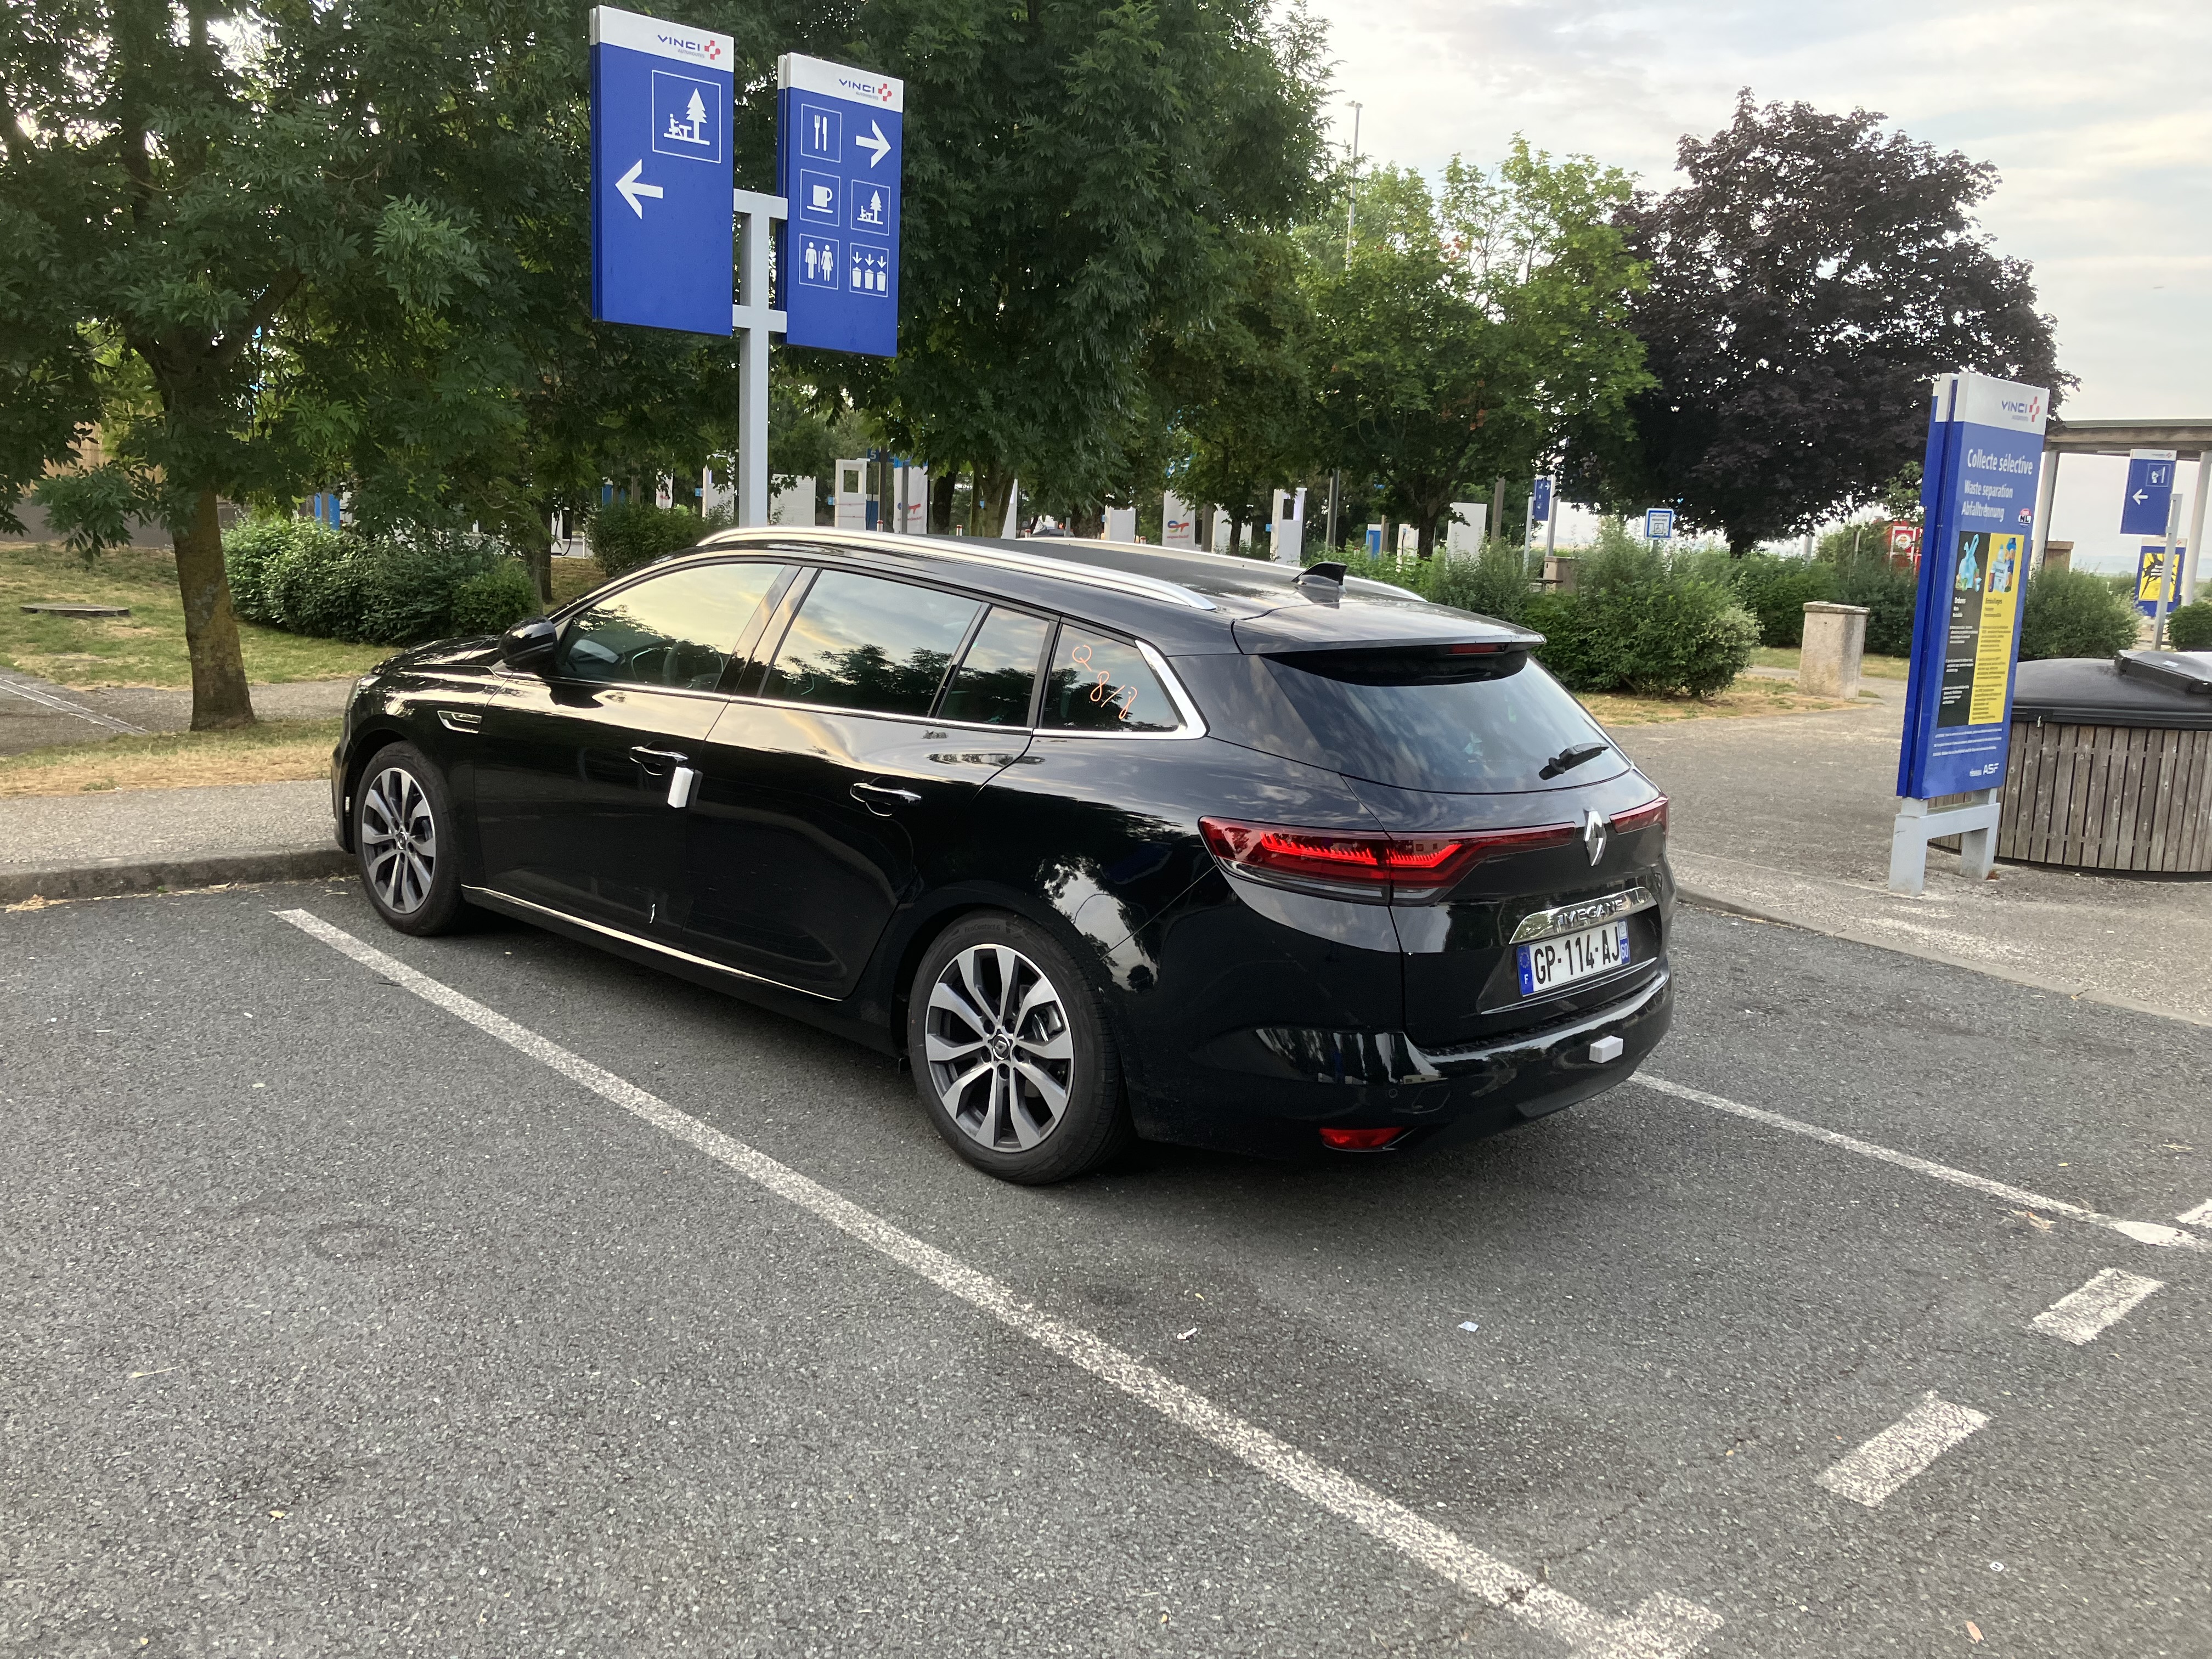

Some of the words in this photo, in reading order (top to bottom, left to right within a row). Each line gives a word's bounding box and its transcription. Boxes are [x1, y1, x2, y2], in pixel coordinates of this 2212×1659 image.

[657, 35, 700, 51] VINCI
[678, 49, 705, 58] AUTOROUTES
[839, 78, 874, 93] VINCI
[2001, 400, 2028, 413] VINCI
[1967, 448, 1997, 471] Collecte
[1999, 453, 2033, 475] sélective
[1964, 479, 1982, 495] Waste
[1982, 483, 2013, 500] separation
[1961, 501, 2005, 522] Abfalltrennung
[1983, 763, 1999, 775] ASF
[1560, 899, 1623, 925] MEGANE
[1534, 926, 1619, 984] GP-114-AJ
[1621, 943, 1629, 959] 60
[1523, 974, 1528, 985] F
